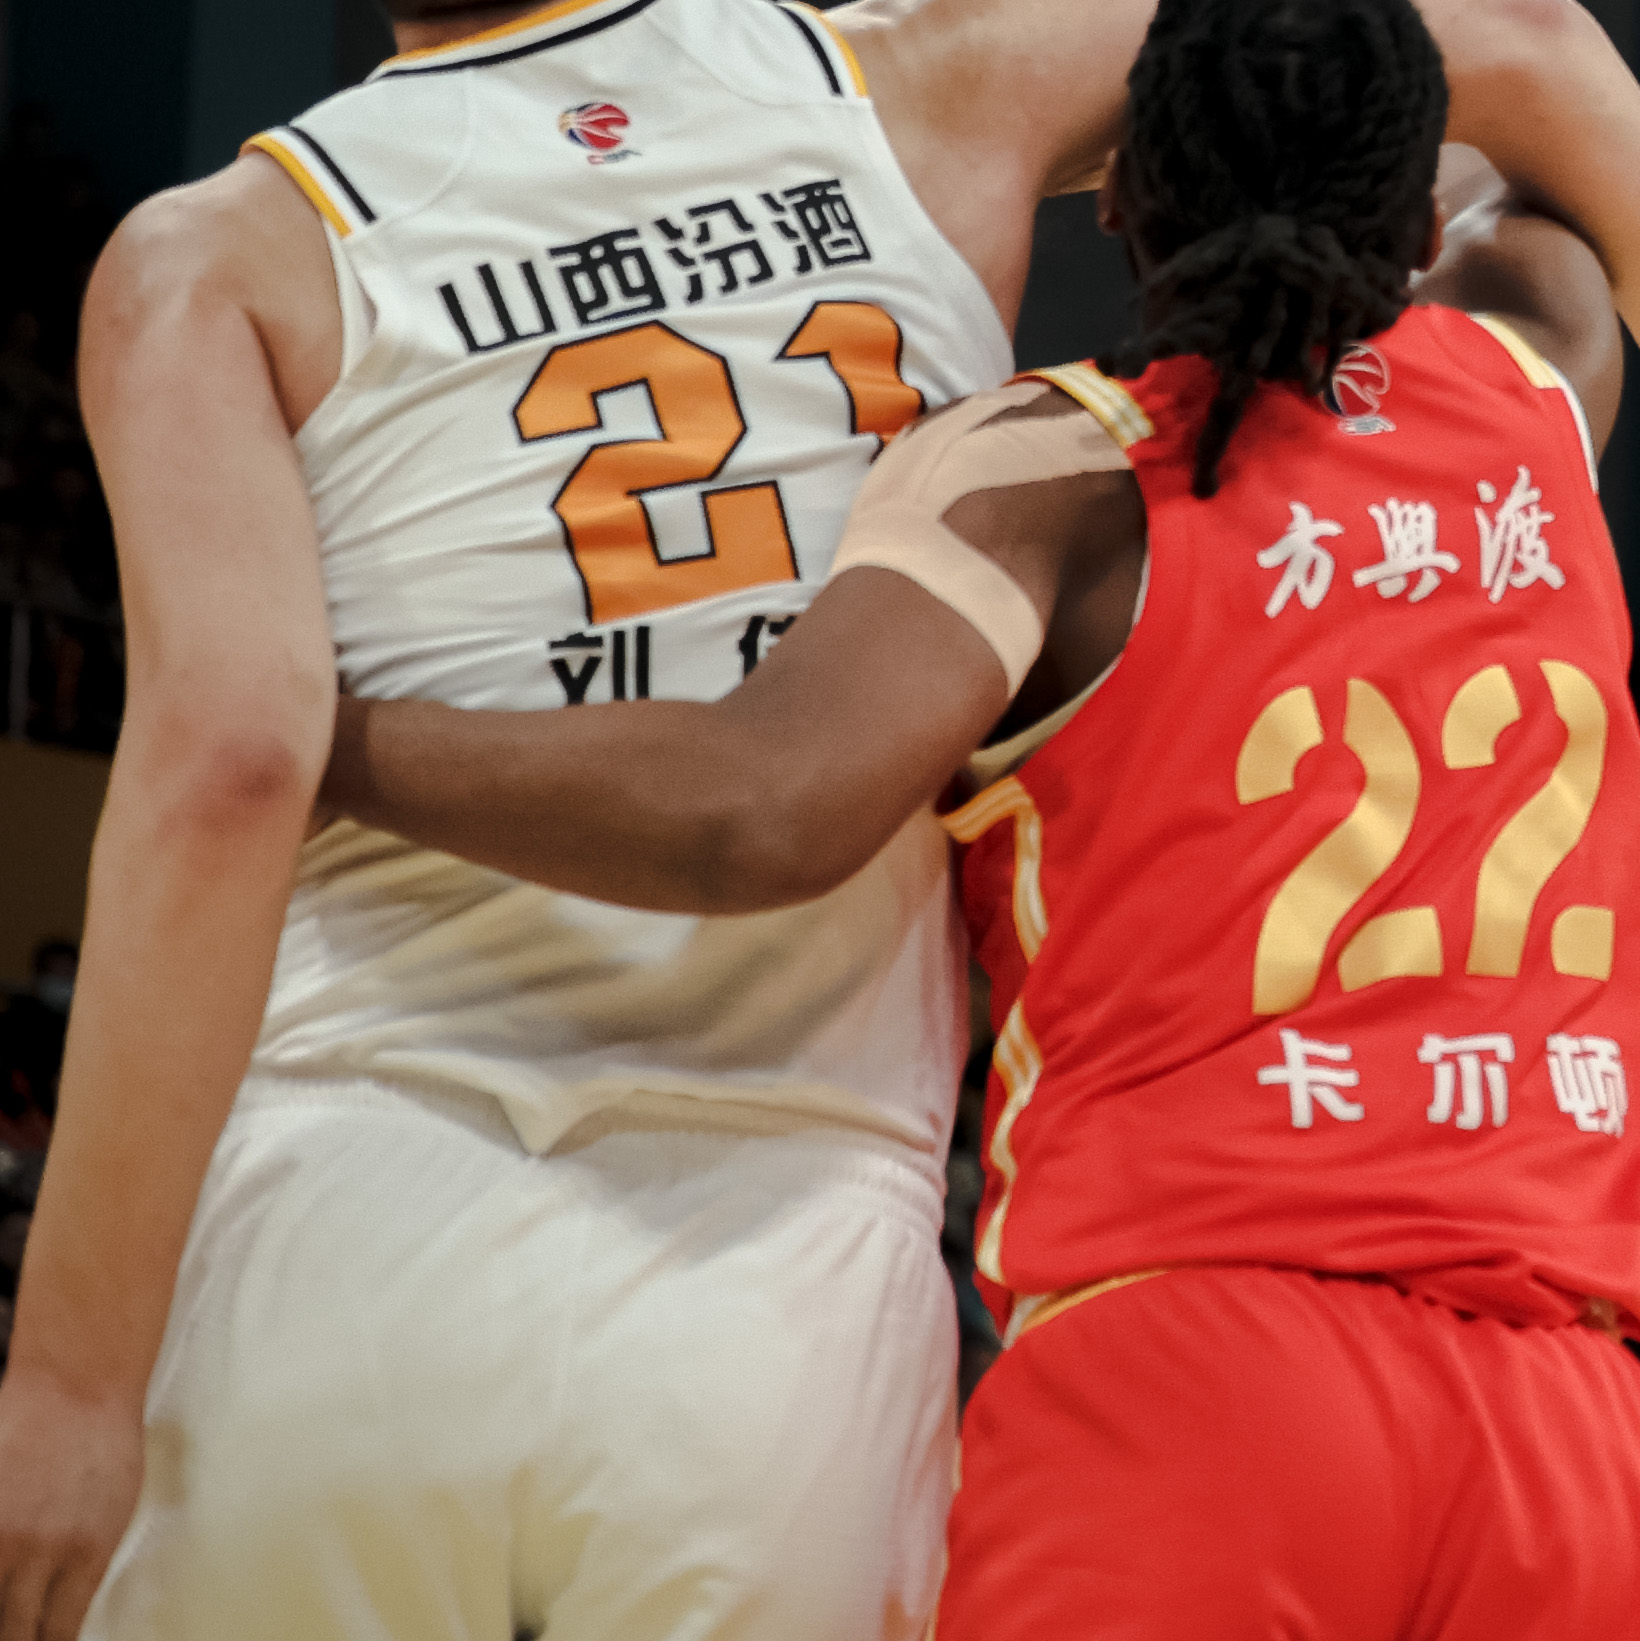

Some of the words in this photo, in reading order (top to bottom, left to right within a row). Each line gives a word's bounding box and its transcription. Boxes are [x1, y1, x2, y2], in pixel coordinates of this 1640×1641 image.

[438, 179, 873, 354] 山西汾酒
[1236, 658, 1616, 1017] 22
[1257, 1028, 1628, 1137] 卡尔顿
